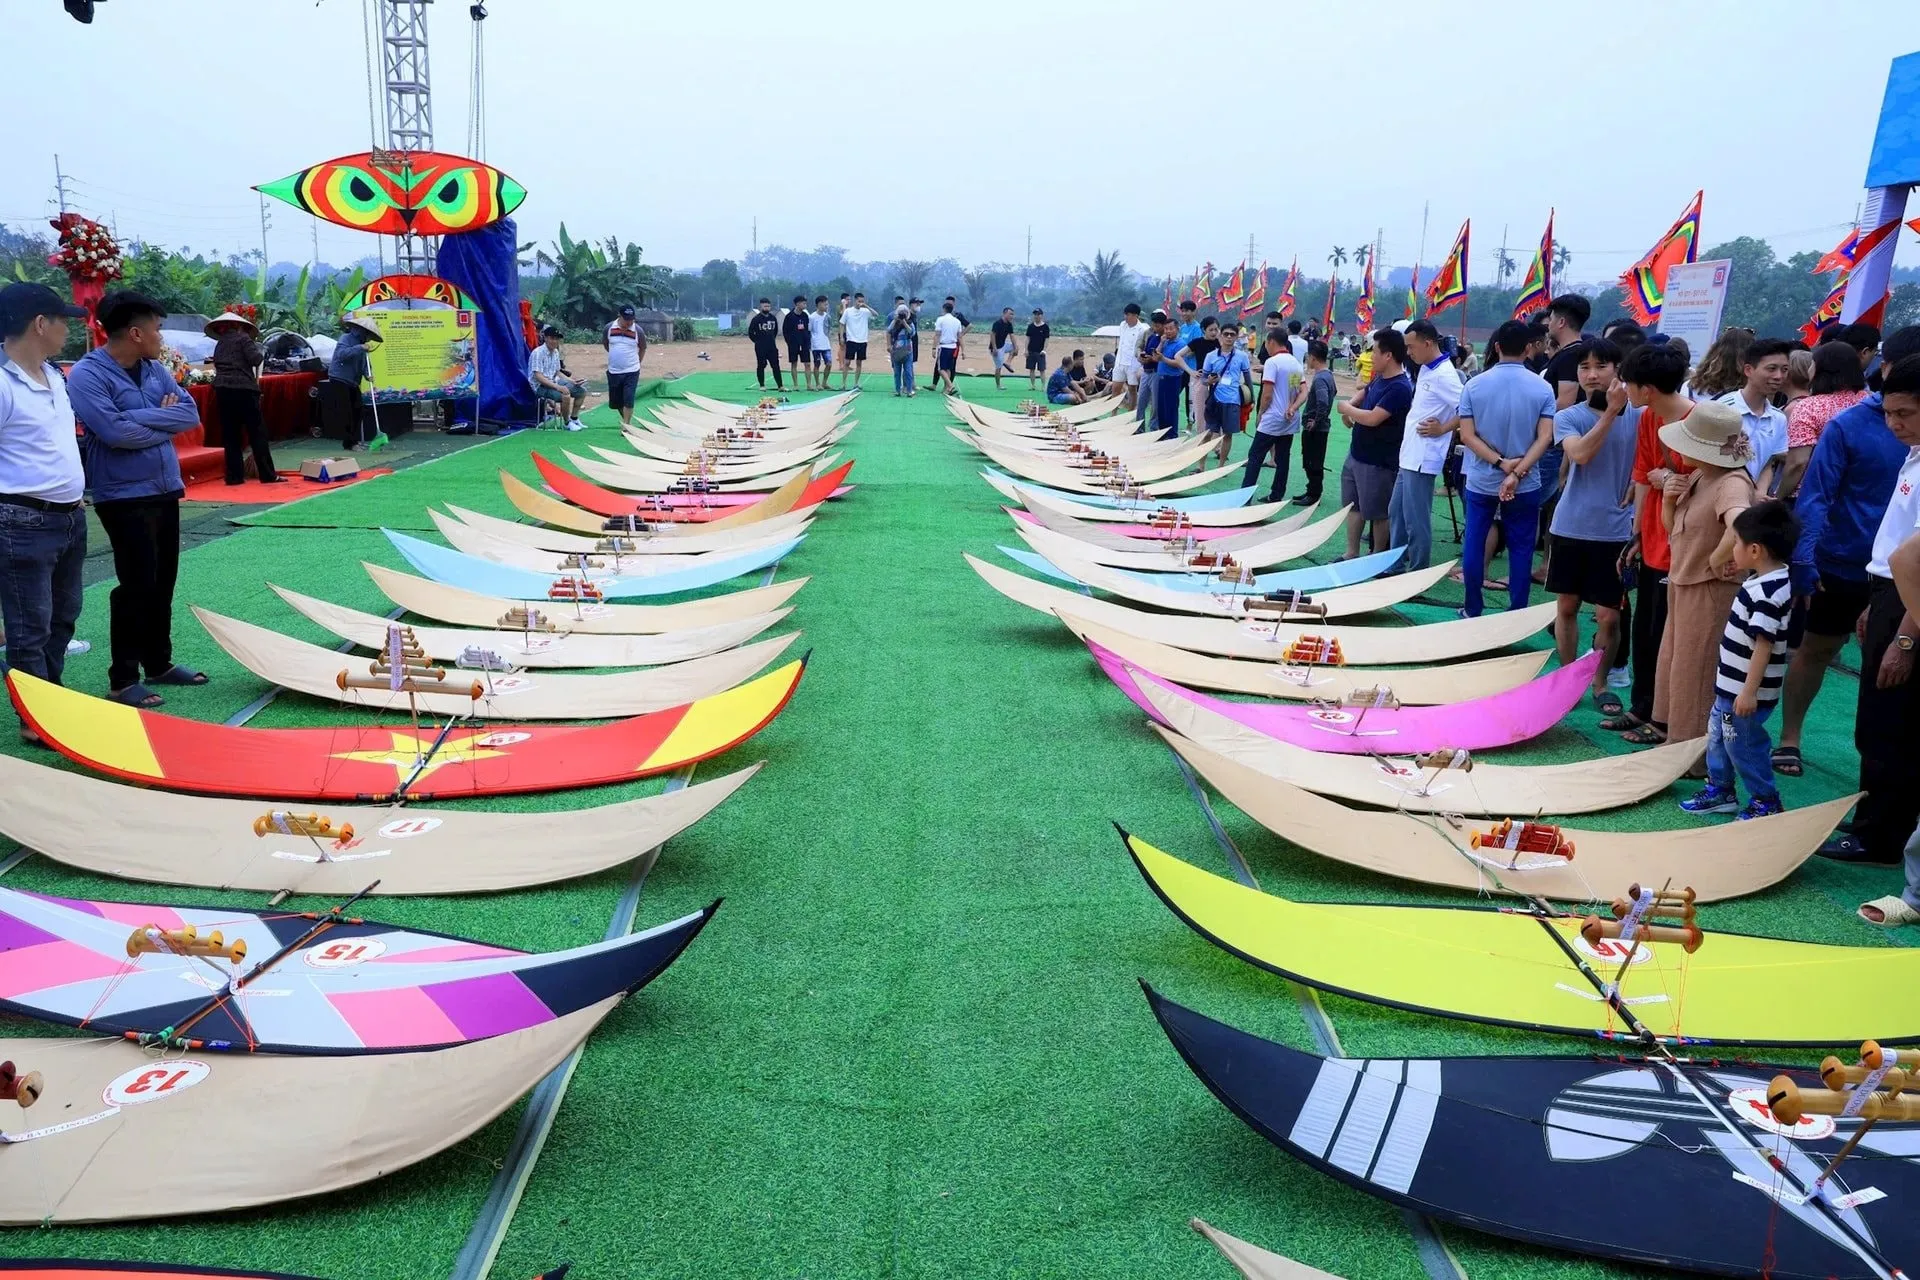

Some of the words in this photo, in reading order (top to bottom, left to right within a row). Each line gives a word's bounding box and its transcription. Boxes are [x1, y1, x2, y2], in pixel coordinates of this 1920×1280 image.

[1723, 713, 1731, 721] Y
[391, 822, 428, 833] 17
[318, 944, 368, 961] 15
[124, 1070, 189, 1094] 13
